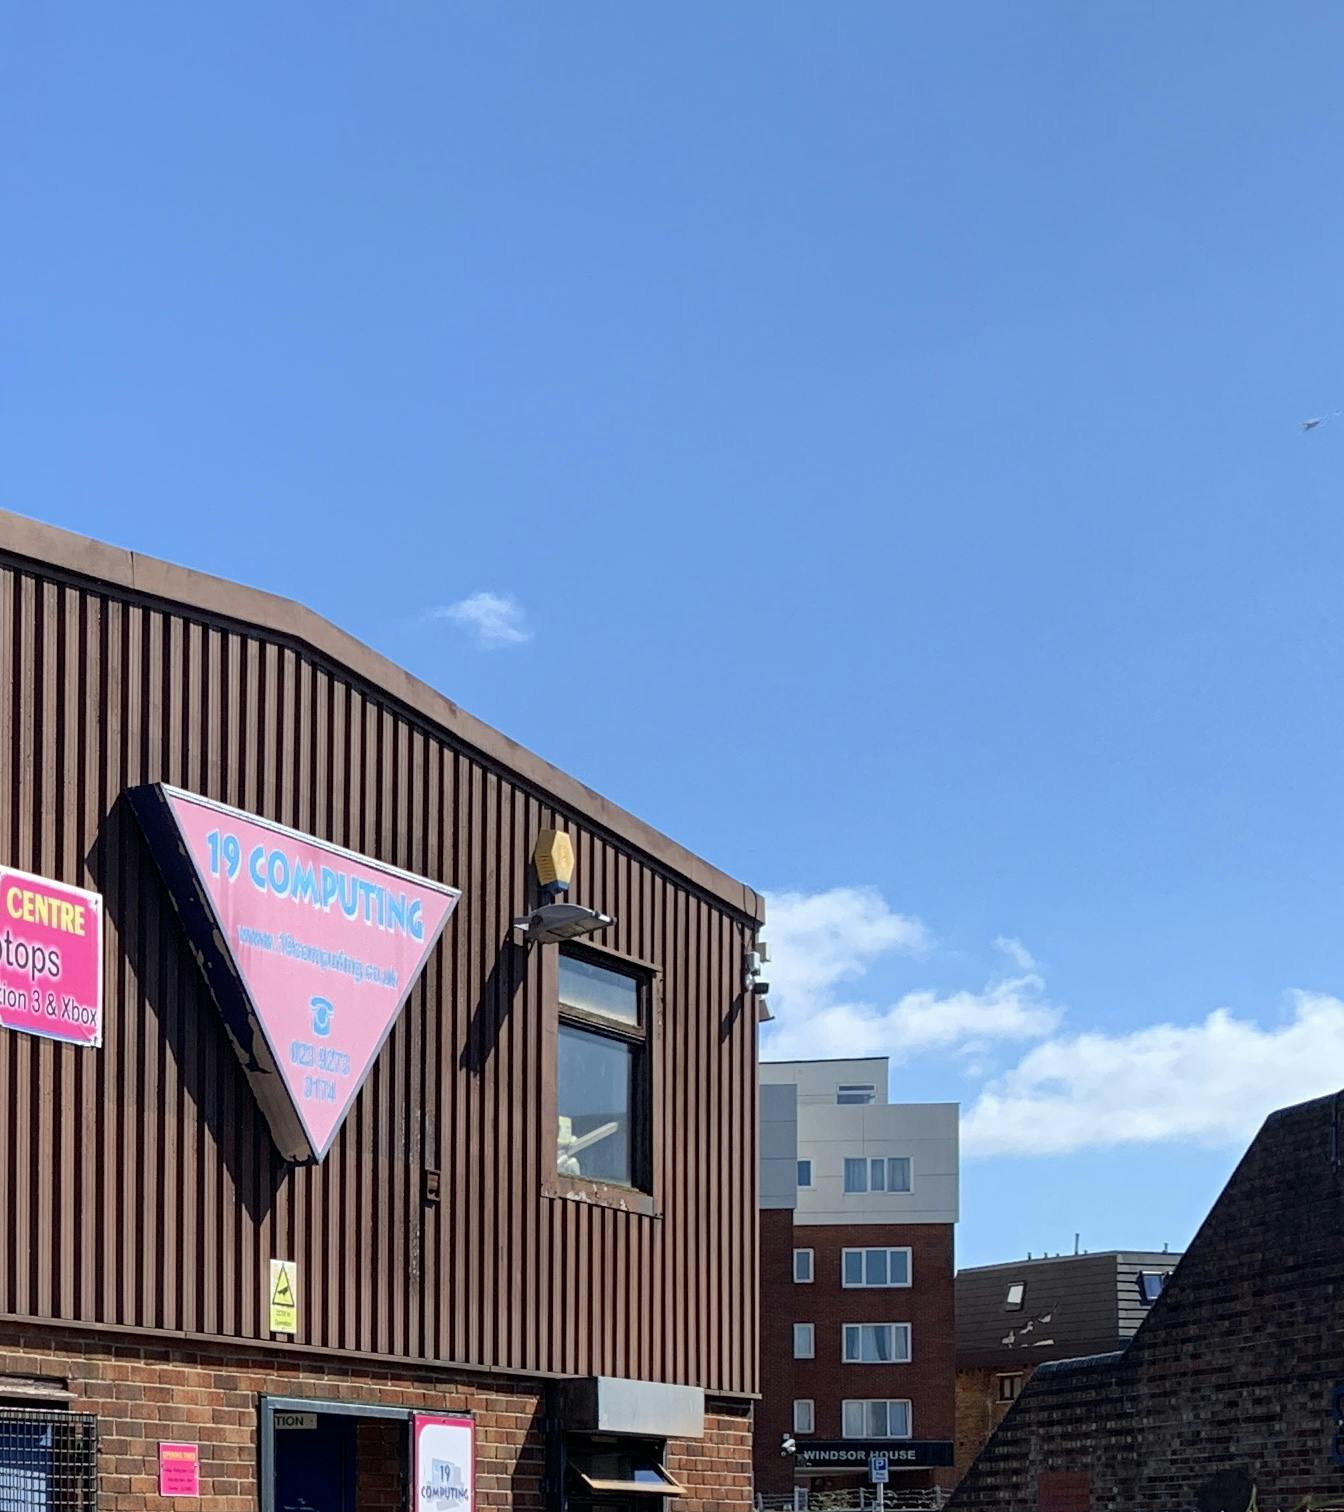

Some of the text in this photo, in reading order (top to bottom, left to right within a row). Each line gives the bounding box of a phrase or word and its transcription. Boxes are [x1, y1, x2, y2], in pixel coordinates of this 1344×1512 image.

[207, 828, 425, 942] 19 COMPUTING
[6, 887, 86, 936] CENTRE
[31, 990, 40, 1013] 3
[46, 993, 57, 1017] &
[62, 996, 97, 1027] Xbox
[803, 1450, 916, 1460] WINDSOR HOUSE
[440, 1464, 451, 1483] 19
[421, 1484, 469, 1500] COMPUTING
